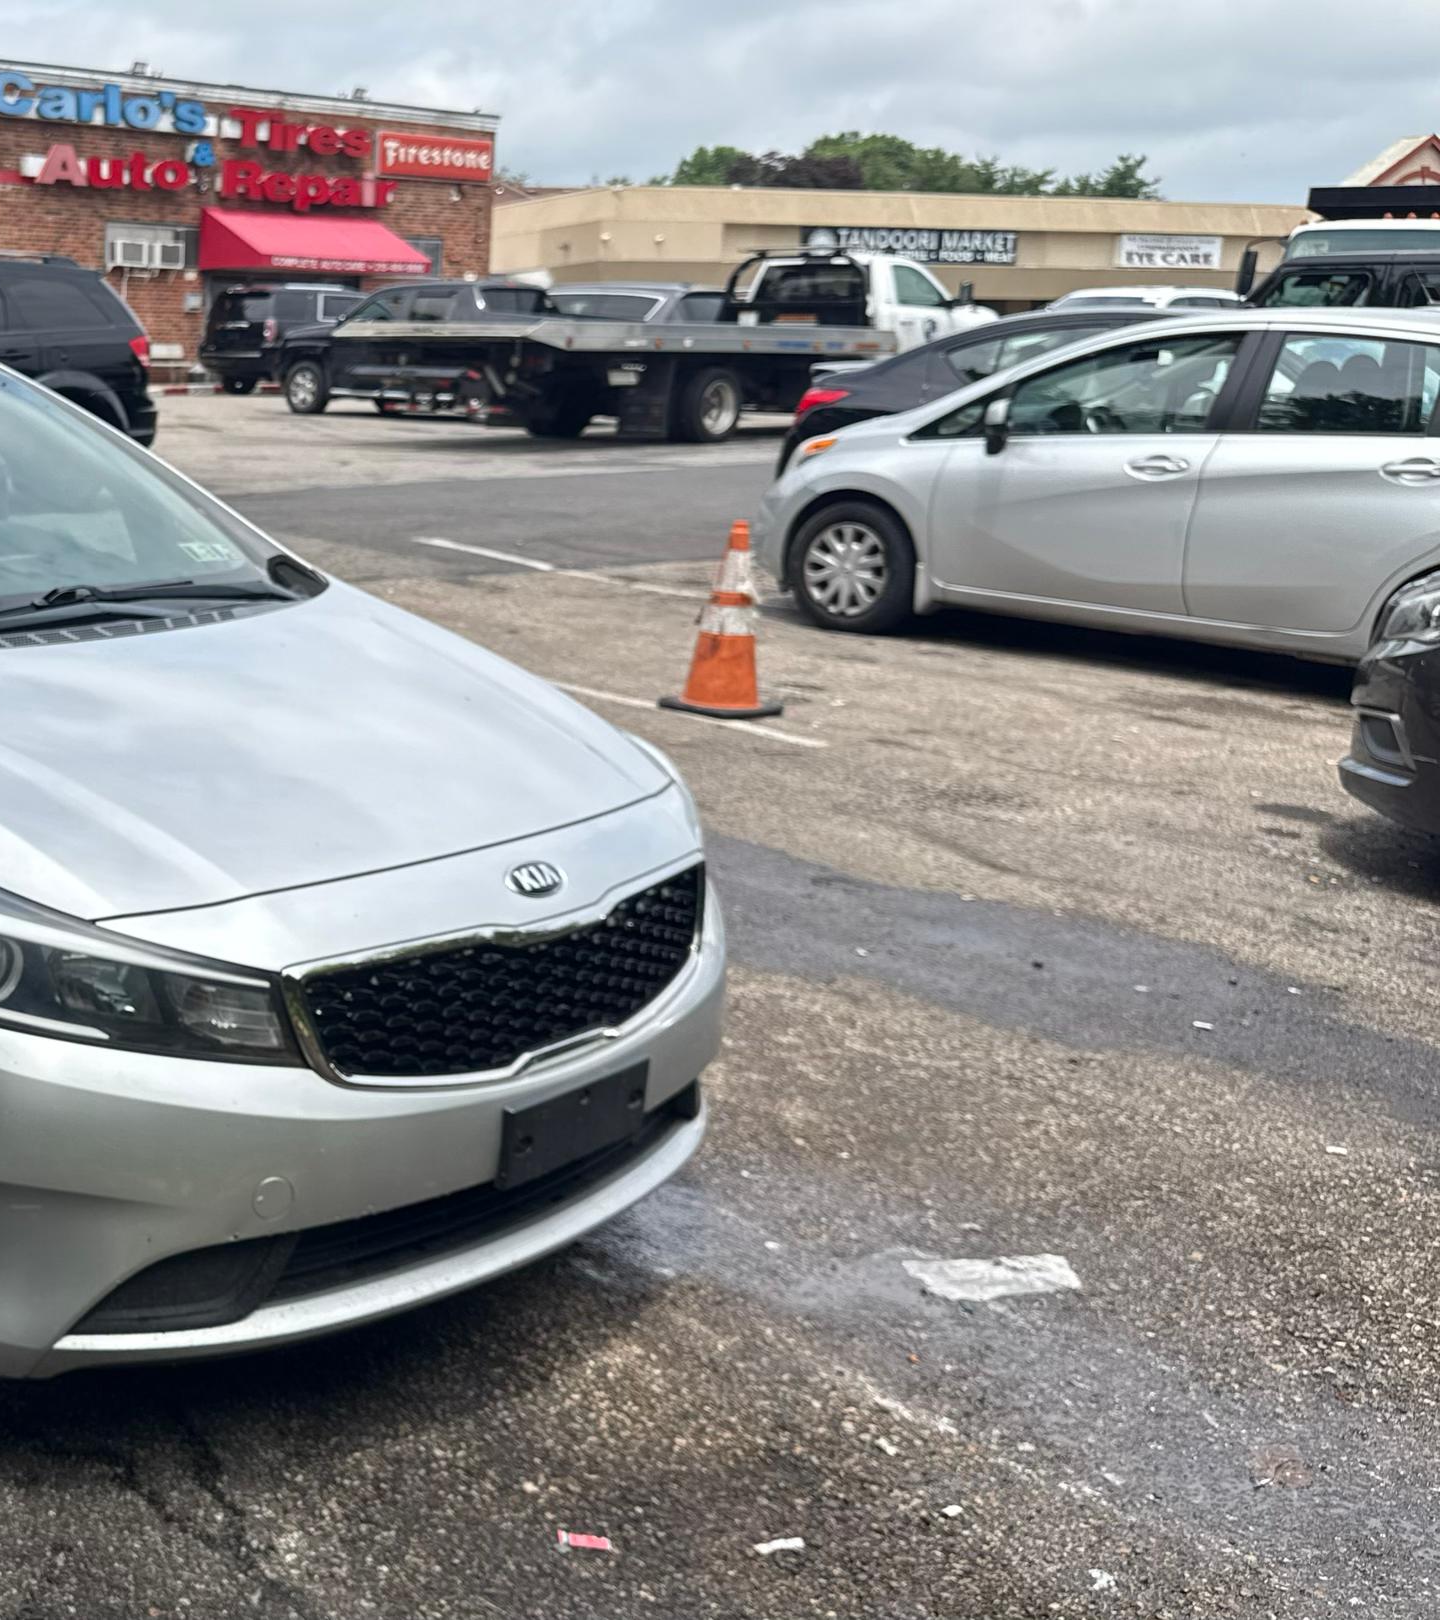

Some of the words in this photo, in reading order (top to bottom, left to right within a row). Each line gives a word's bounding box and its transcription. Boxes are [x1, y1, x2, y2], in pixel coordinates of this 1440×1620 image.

[230, 106, 372, 158] Tires
[192, 141, 215, 168] &
[383, 137, 492, 170] Firestone
[35, 143, 191, 191] Auto
[220, 158, 399, 212] Repair
[836, 228, 939, 250] TANDOORI
[941, 231, 1018, 252] MARKET
[1126, 251, 1157, 264] EYE
[1161, 253, 1213, 265] CARE
[513, 863, 560, 891] KIA
